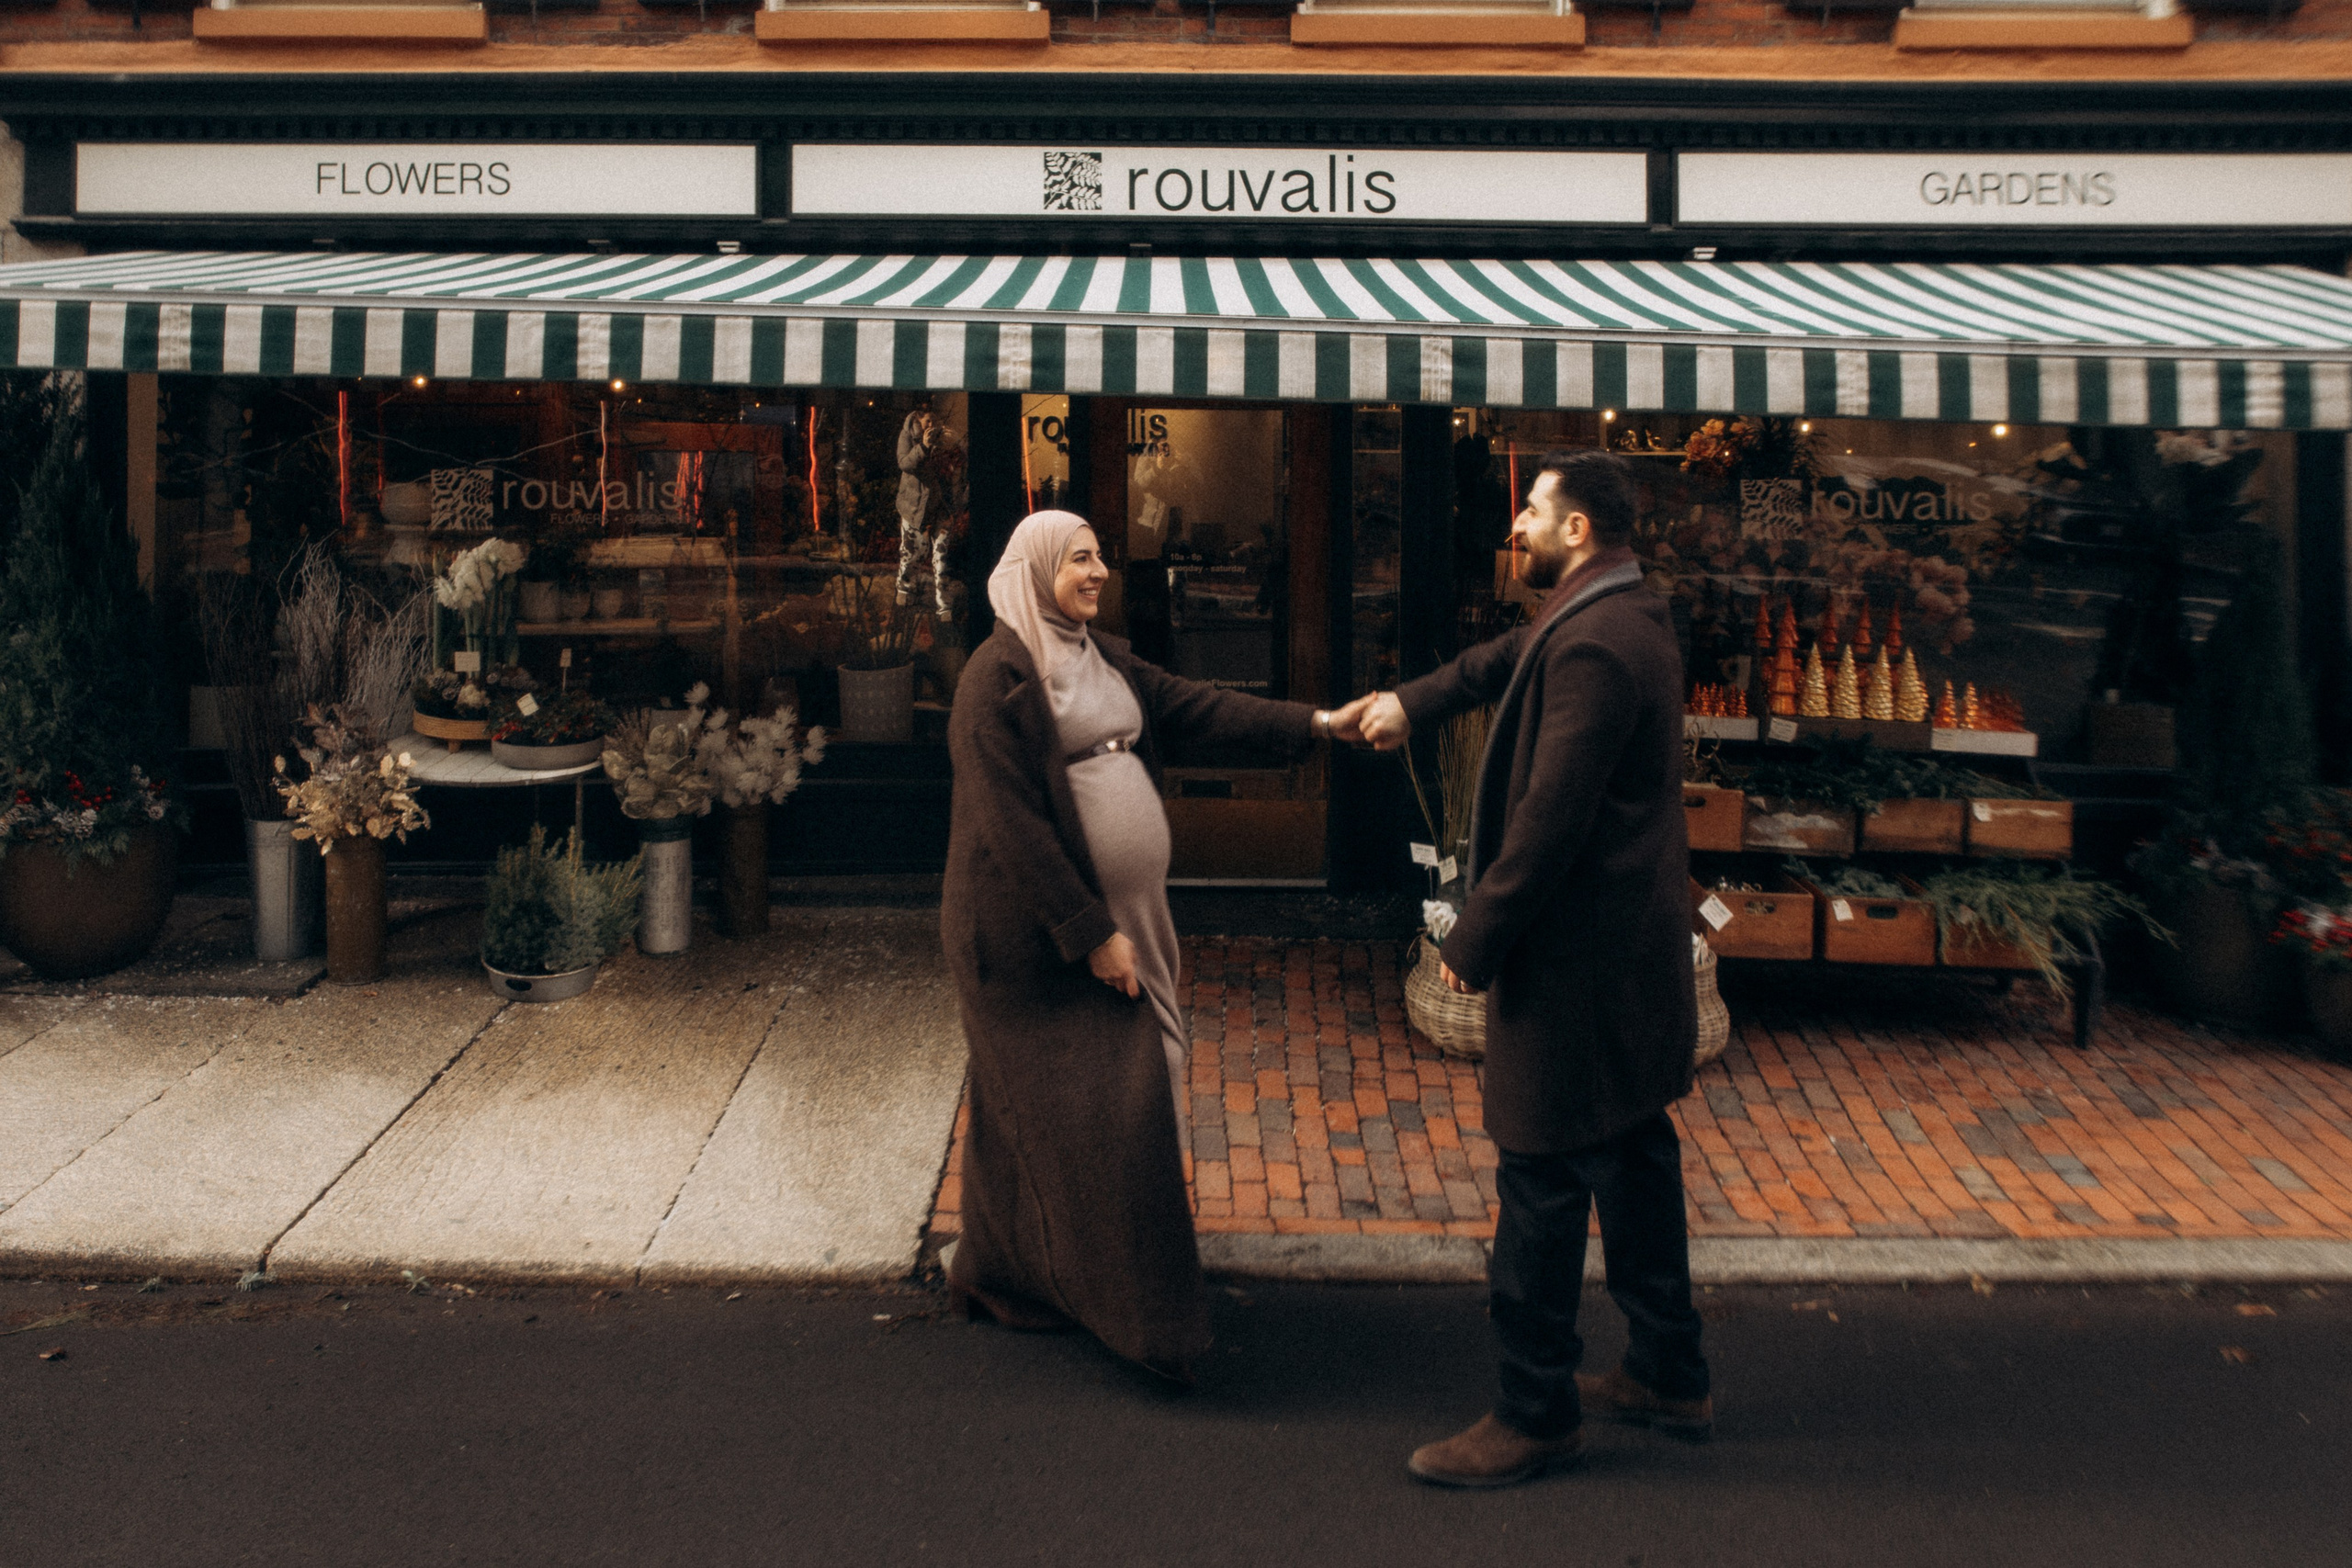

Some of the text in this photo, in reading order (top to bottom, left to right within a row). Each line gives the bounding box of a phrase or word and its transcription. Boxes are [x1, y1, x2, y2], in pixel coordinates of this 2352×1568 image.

[317, 162, 511, 195] FLOWERS
[1128, 153, 1396, 212] rouvalis
[1920, 172, 2116, 205] GARDENS
[503, 470, 683, 510] rouvalis
[1811, 481, 1992, 521] rouvalis
[1210, 565, 1247, 573] saturday
